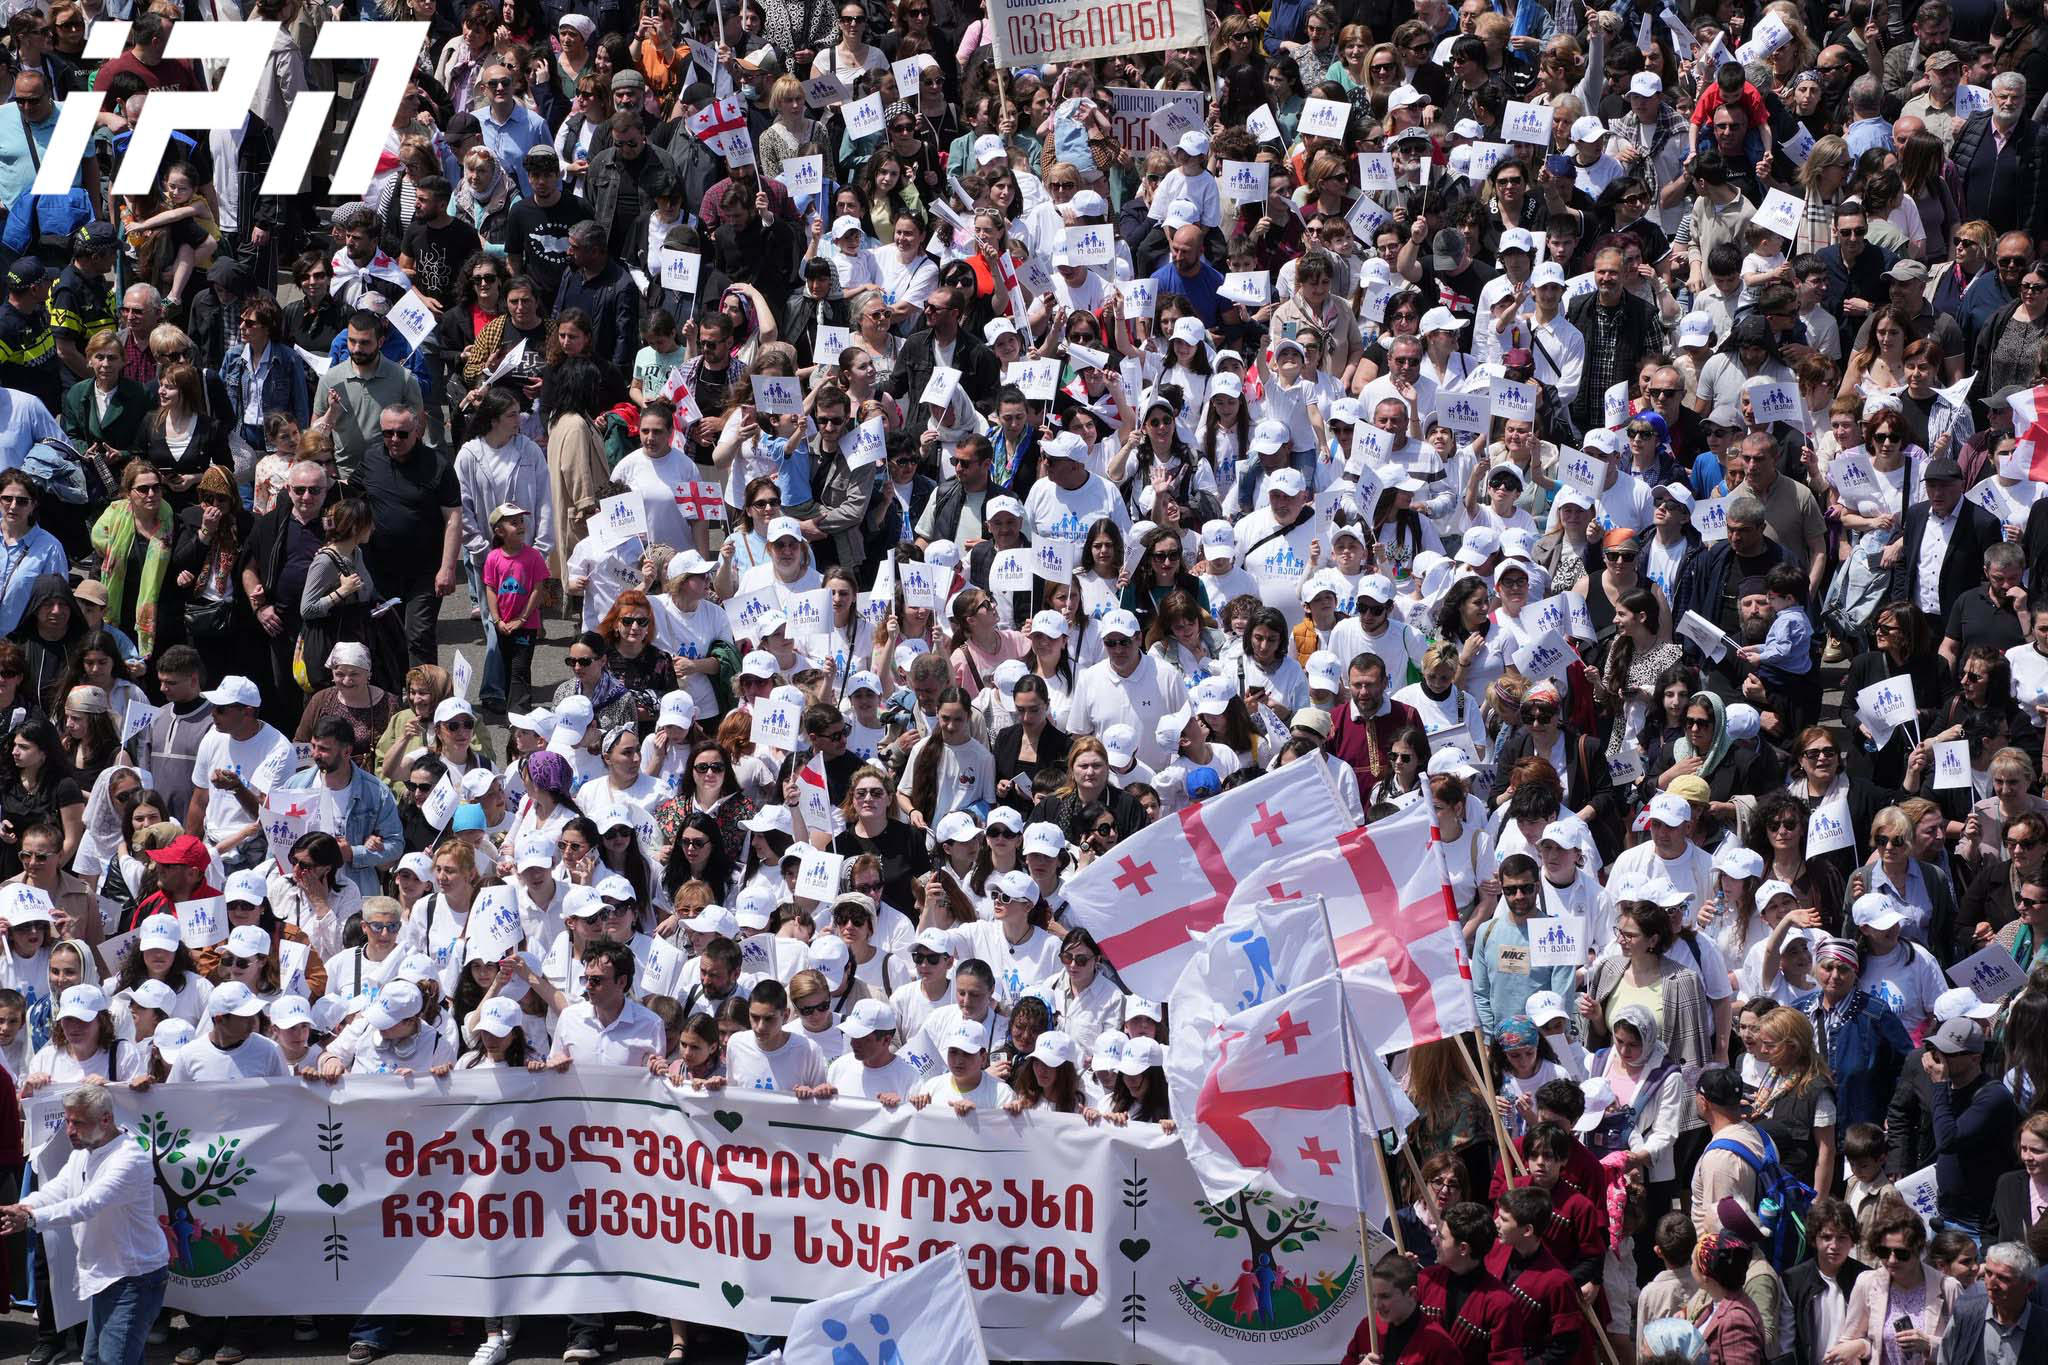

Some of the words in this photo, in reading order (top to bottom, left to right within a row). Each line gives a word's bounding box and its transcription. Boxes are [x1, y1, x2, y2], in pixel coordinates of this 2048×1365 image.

[1008, 0, 1175, 56] ივერიონი
[1522, 125, 1542, 134] მაისი
[1087, 247, 1106, 255] მაისი
[1508, 401, 1528, 411] მაისი
[1458, 415, 1479, 423] მაისი
[1575, 475, 1594, 486] მაისი
[1264, 565, 1273, 573] 17
[1277, 567, 1304, 575] მაისი
[1542, 652, 1563, 668] მაისი
[1883, 701, 1905, 713] მაისი
[771, 727, 789, 737] მაისი
[1818, 828, 1843, 840] მაისი
[1501, 951, 1526, 960] NIKE
[1985, 972, 2009, 987] მაისი
[385, 1125, 889, 1211] მრავალშვილიანი
[901, 1171, 1094, 1233] ოჯახი
[382, 1189, 544, 1240] ჩვენი
[567, 1188, 771, 1261] ქვეყნის
[191, 1266, 240, 1288] დედები
[240, 1215, 286, 1271] სიძლიერეა
[1169, 1282, 1266, 1343] მრავალშვილიანი
[1270, 1322, 1320, 1342] დედები
[1321, 1264, 1364, 1324] სიძლიერეა
